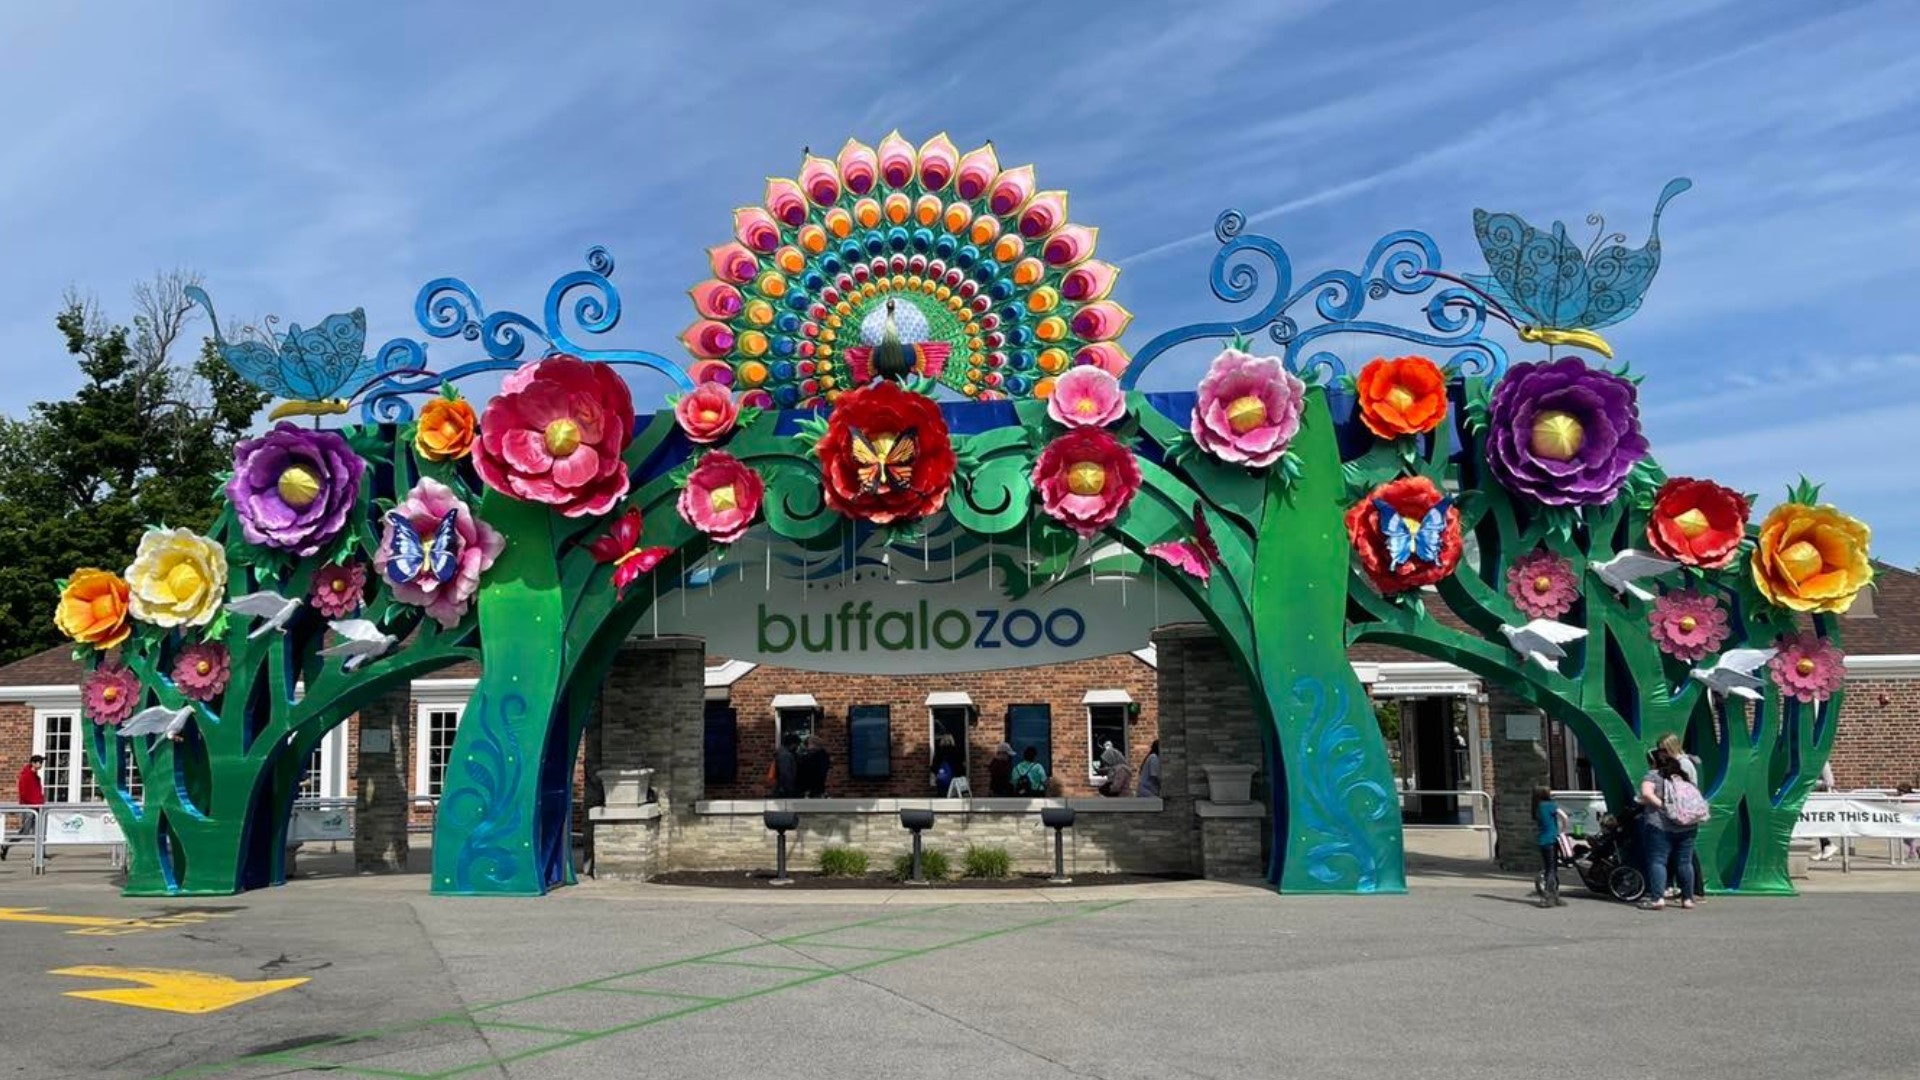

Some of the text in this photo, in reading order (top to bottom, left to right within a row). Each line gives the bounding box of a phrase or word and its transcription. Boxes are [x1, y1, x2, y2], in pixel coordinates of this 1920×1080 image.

[1797, 811, 1901, 823] NTER THIS LINE
